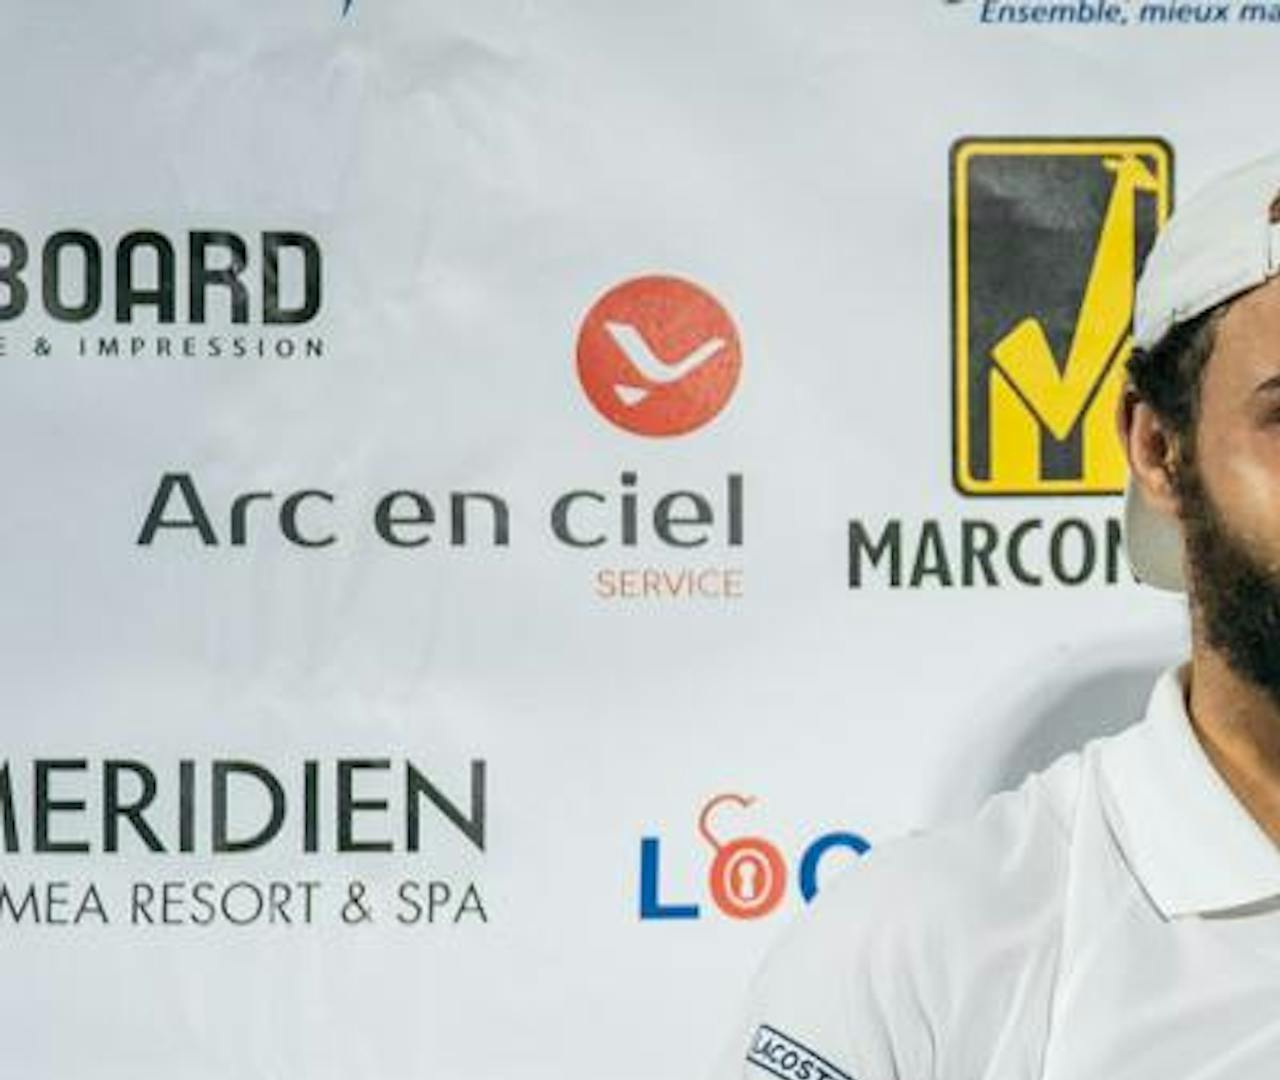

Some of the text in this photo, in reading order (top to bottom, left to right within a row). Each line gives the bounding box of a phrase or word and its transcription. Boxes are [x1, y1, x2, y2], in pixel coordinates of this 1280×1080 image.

[979, 0, 1129, 25] Ensemble,
[1139, 0, 1229, 23] mieux
[34, 336, 324, 357] & IMPRESSION
[137, 471, 744, 548] Arc en ciel
[597, 569, 744, 599] SERVICE
[132, 881, 321, 926] RESORT
[341, 880, 373, 926] &
[396, 880, 490, 926] SPA
